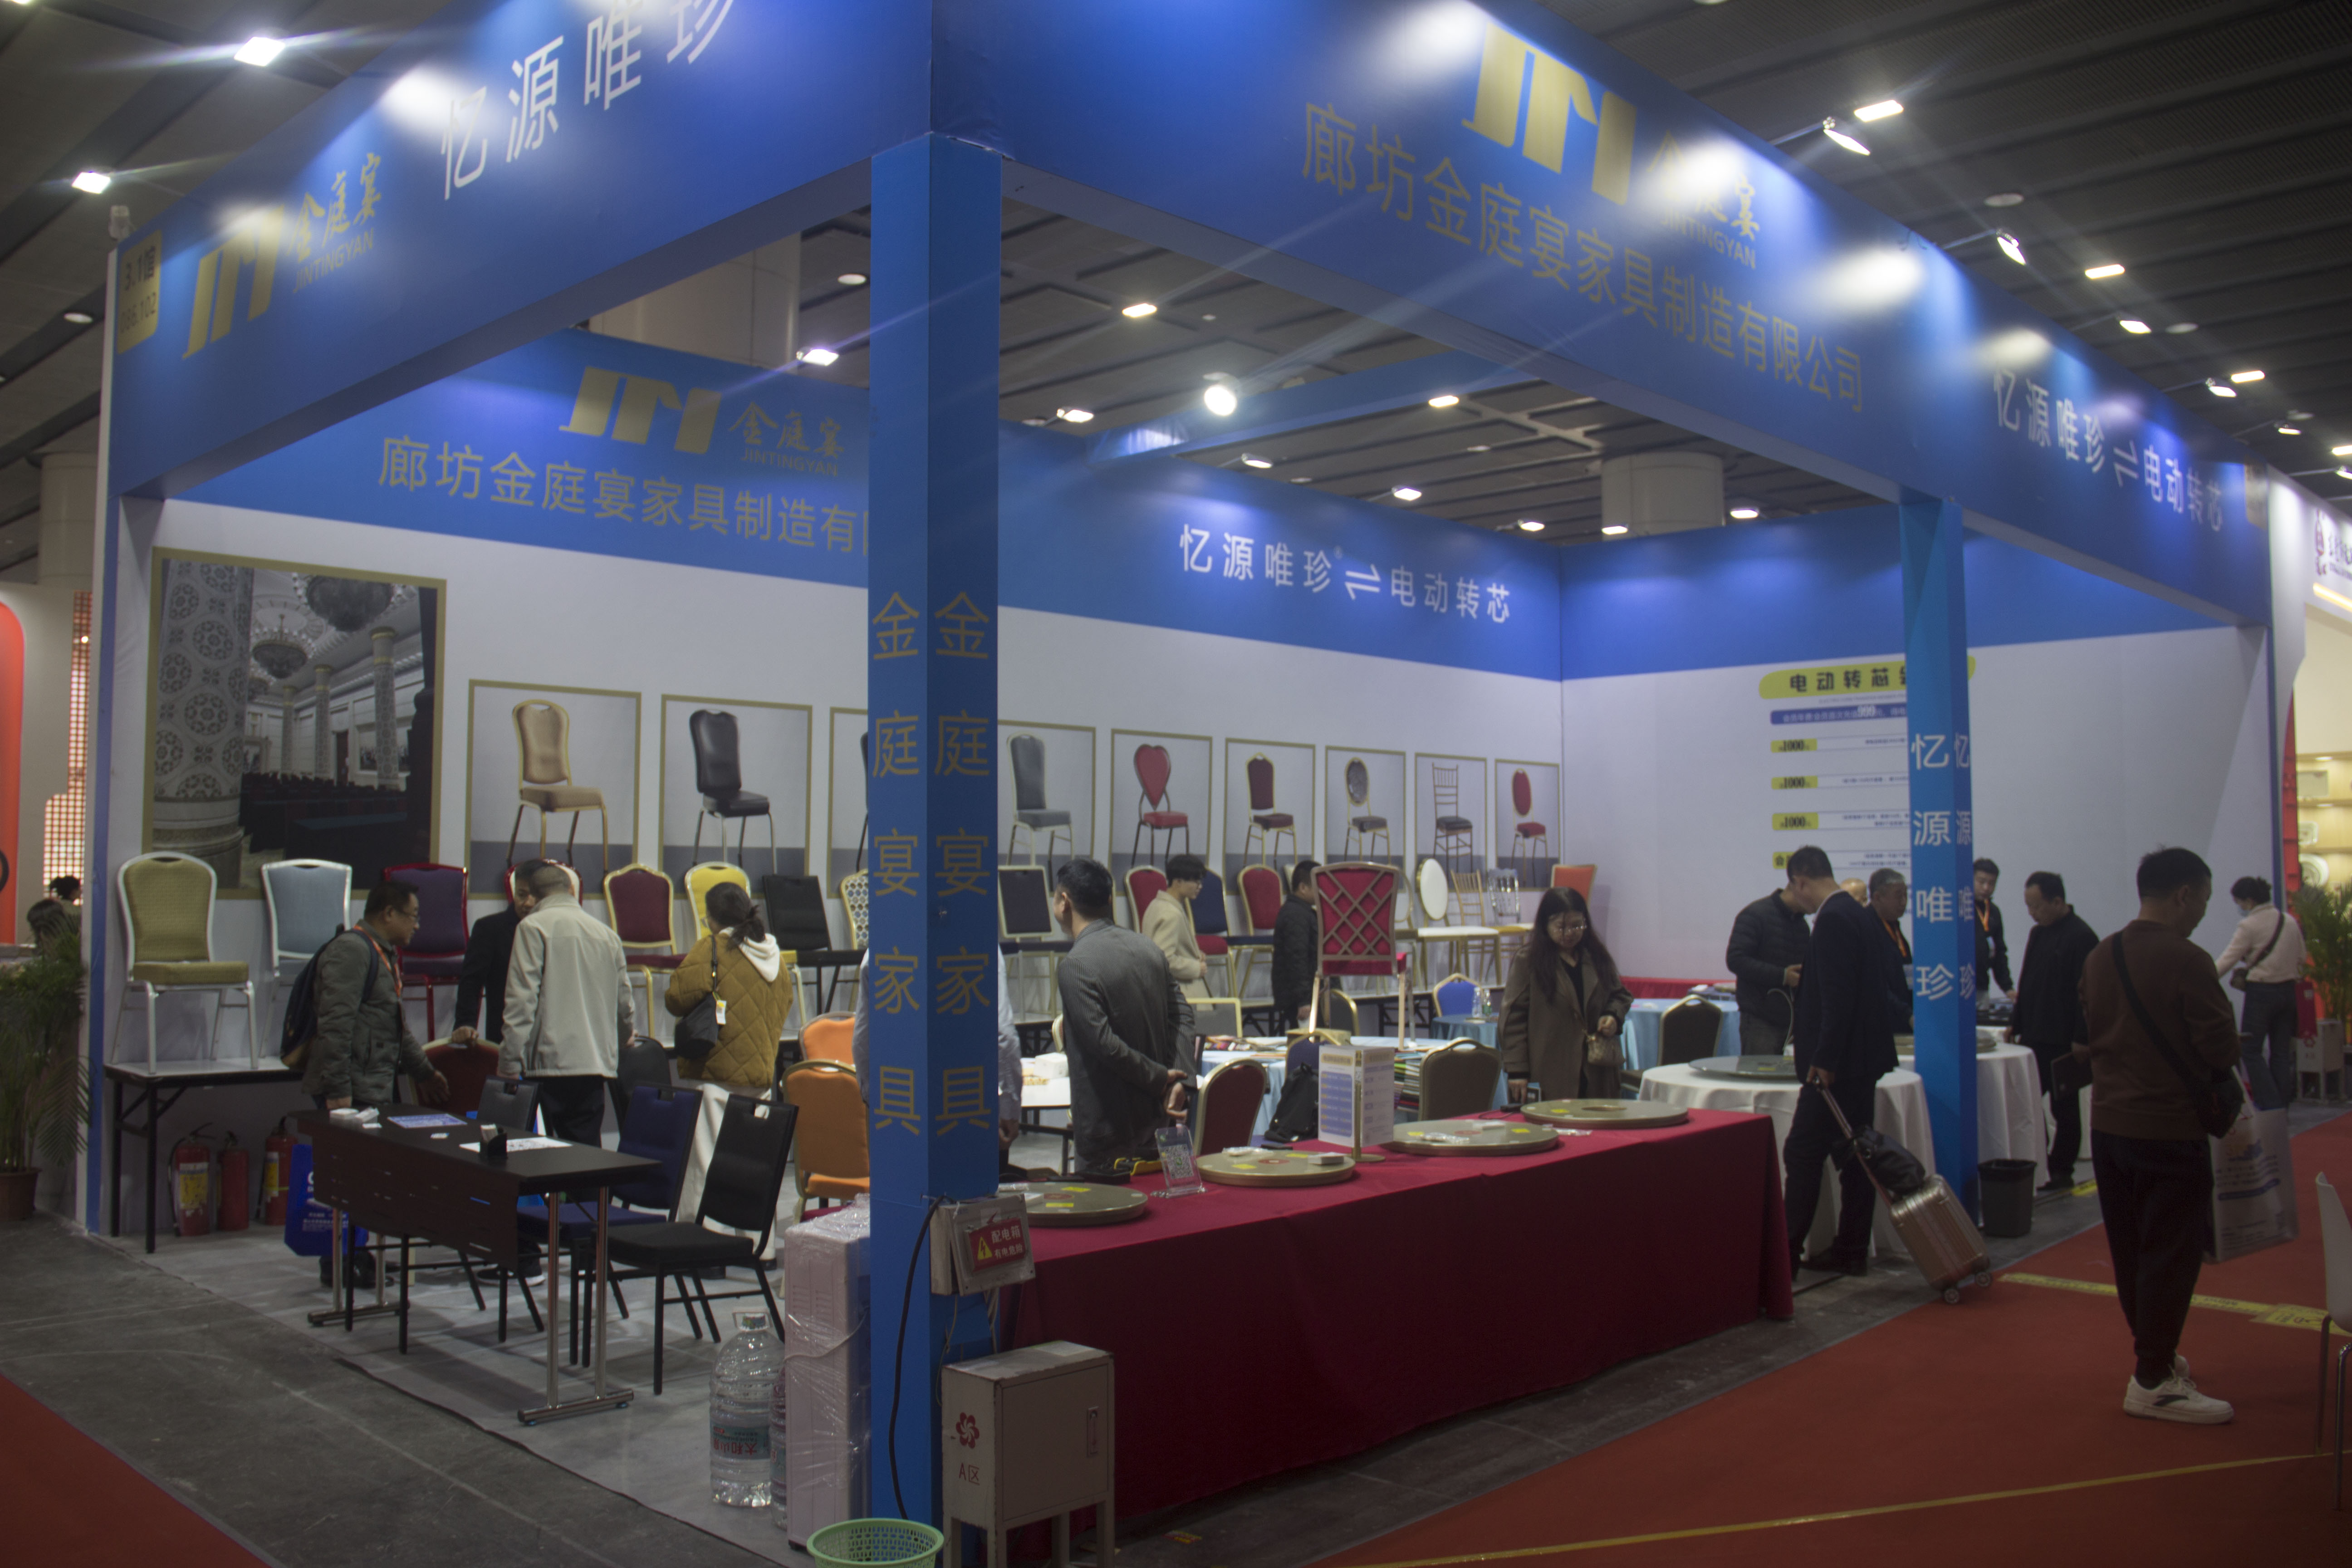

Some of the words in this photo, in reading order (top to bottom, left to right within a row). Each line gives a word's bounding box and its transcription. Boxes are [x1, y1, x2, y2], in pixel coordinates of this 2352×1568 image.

[293, 227, 374, 294] JINTINGYAN
[1302, 101, 1862, 413] 廊坊金庭宴家具制造有限公司
[1661, 206, 1756, 270] JINTINGYAN
[378, 434, 868, 557] 廊坊金庭宴家具制造有
[740, 447, 838, 476] JINTINGYAN
[1994, 368, 2105, 473] 忆源唯珍
[2143, 445, 2223, 532] 电动转芯
[1180, 523, 1332, 593] 忆源唯珍
[1391, 565, 1510, 623] 电动转芯
[872, 591, 921, 1136] 金庭宴家具
[933, 591, 991, 1136] 金庭宴家具
[1911, 733, 1954, 1000] 忆源唯珍
[1954, 732, 1975, 1000] 忆源唯珍
[991, 1225, 1021, 1244] 配电箱
[994, 1243, 1023, 1259] 有电危险
[959, 1462, 980, 1485] A区
